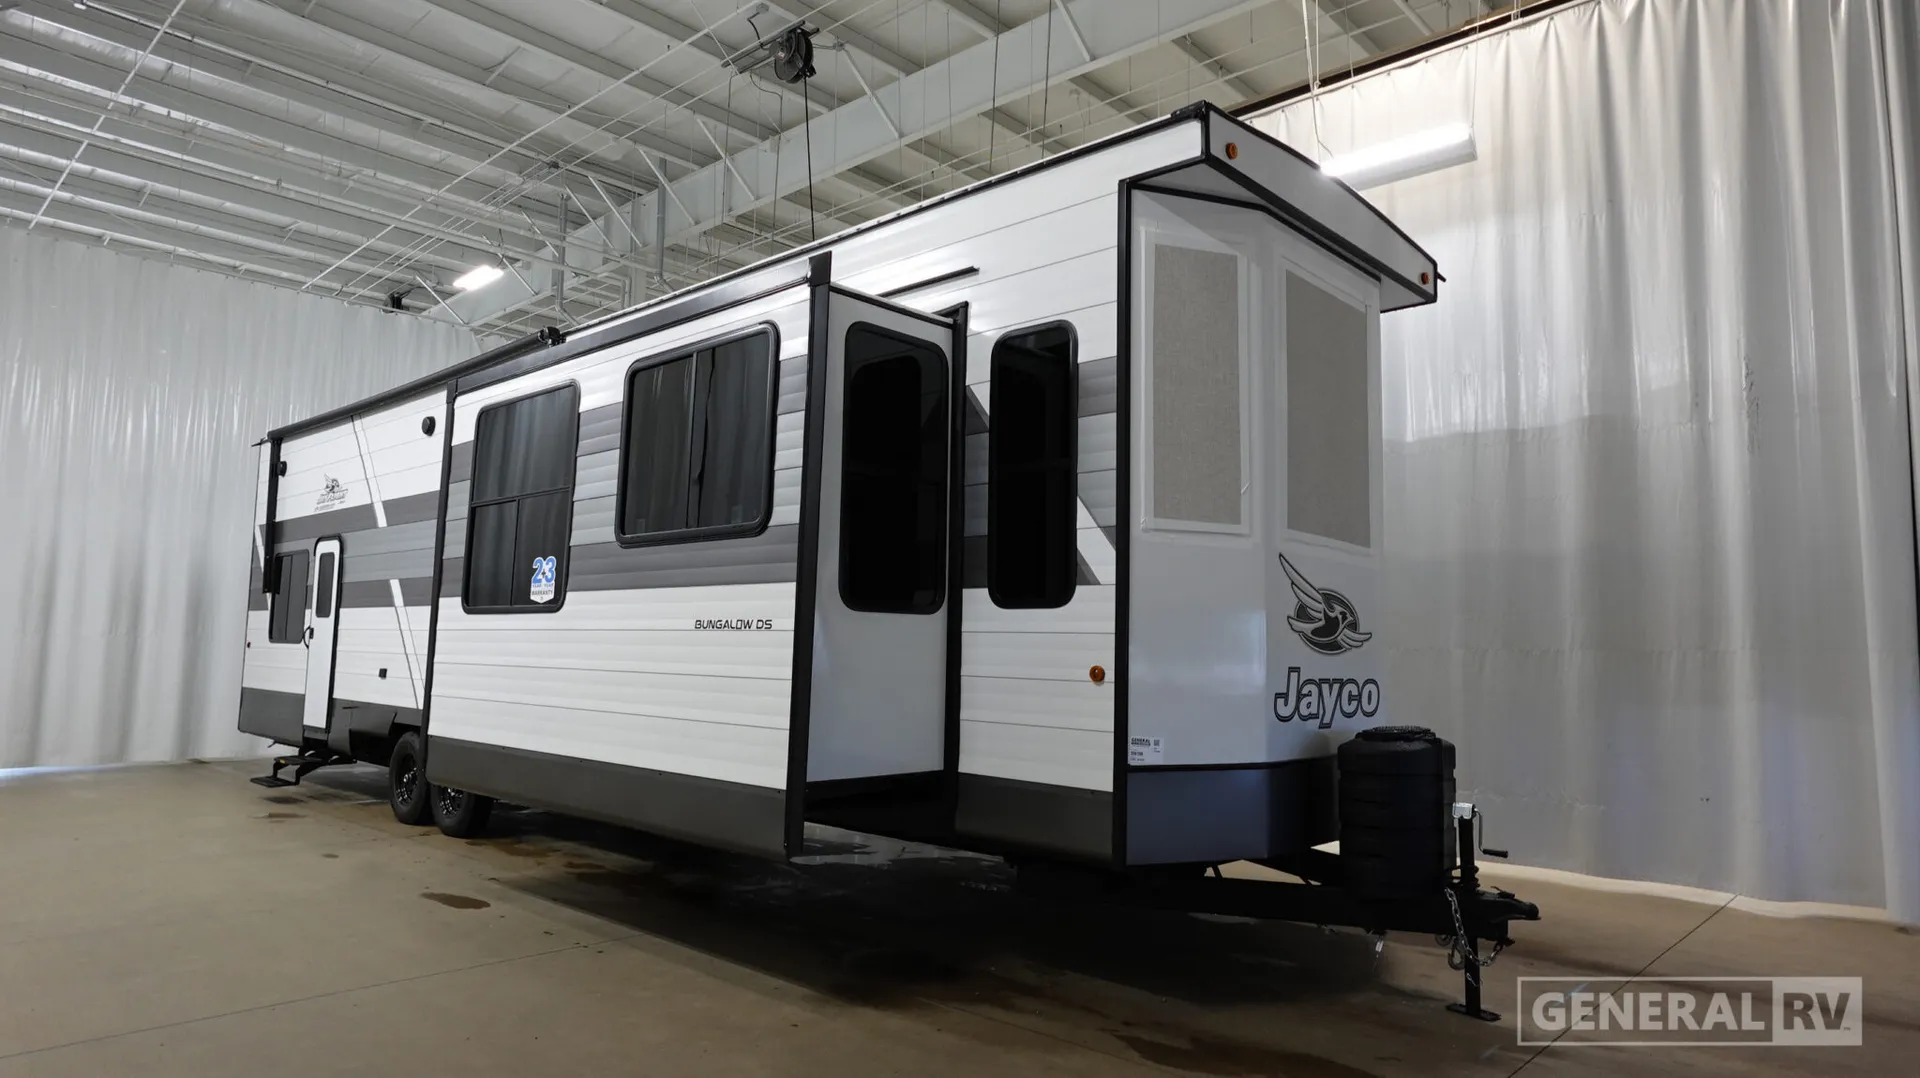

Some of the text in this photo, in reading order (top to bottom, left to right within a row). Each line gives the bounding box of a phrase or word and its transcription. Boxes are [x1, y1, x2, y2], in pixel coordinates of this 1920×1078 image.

[694, 619, 773, 630] BUNGALOW DS
[1274, 666, 1380, 729] Jayco
